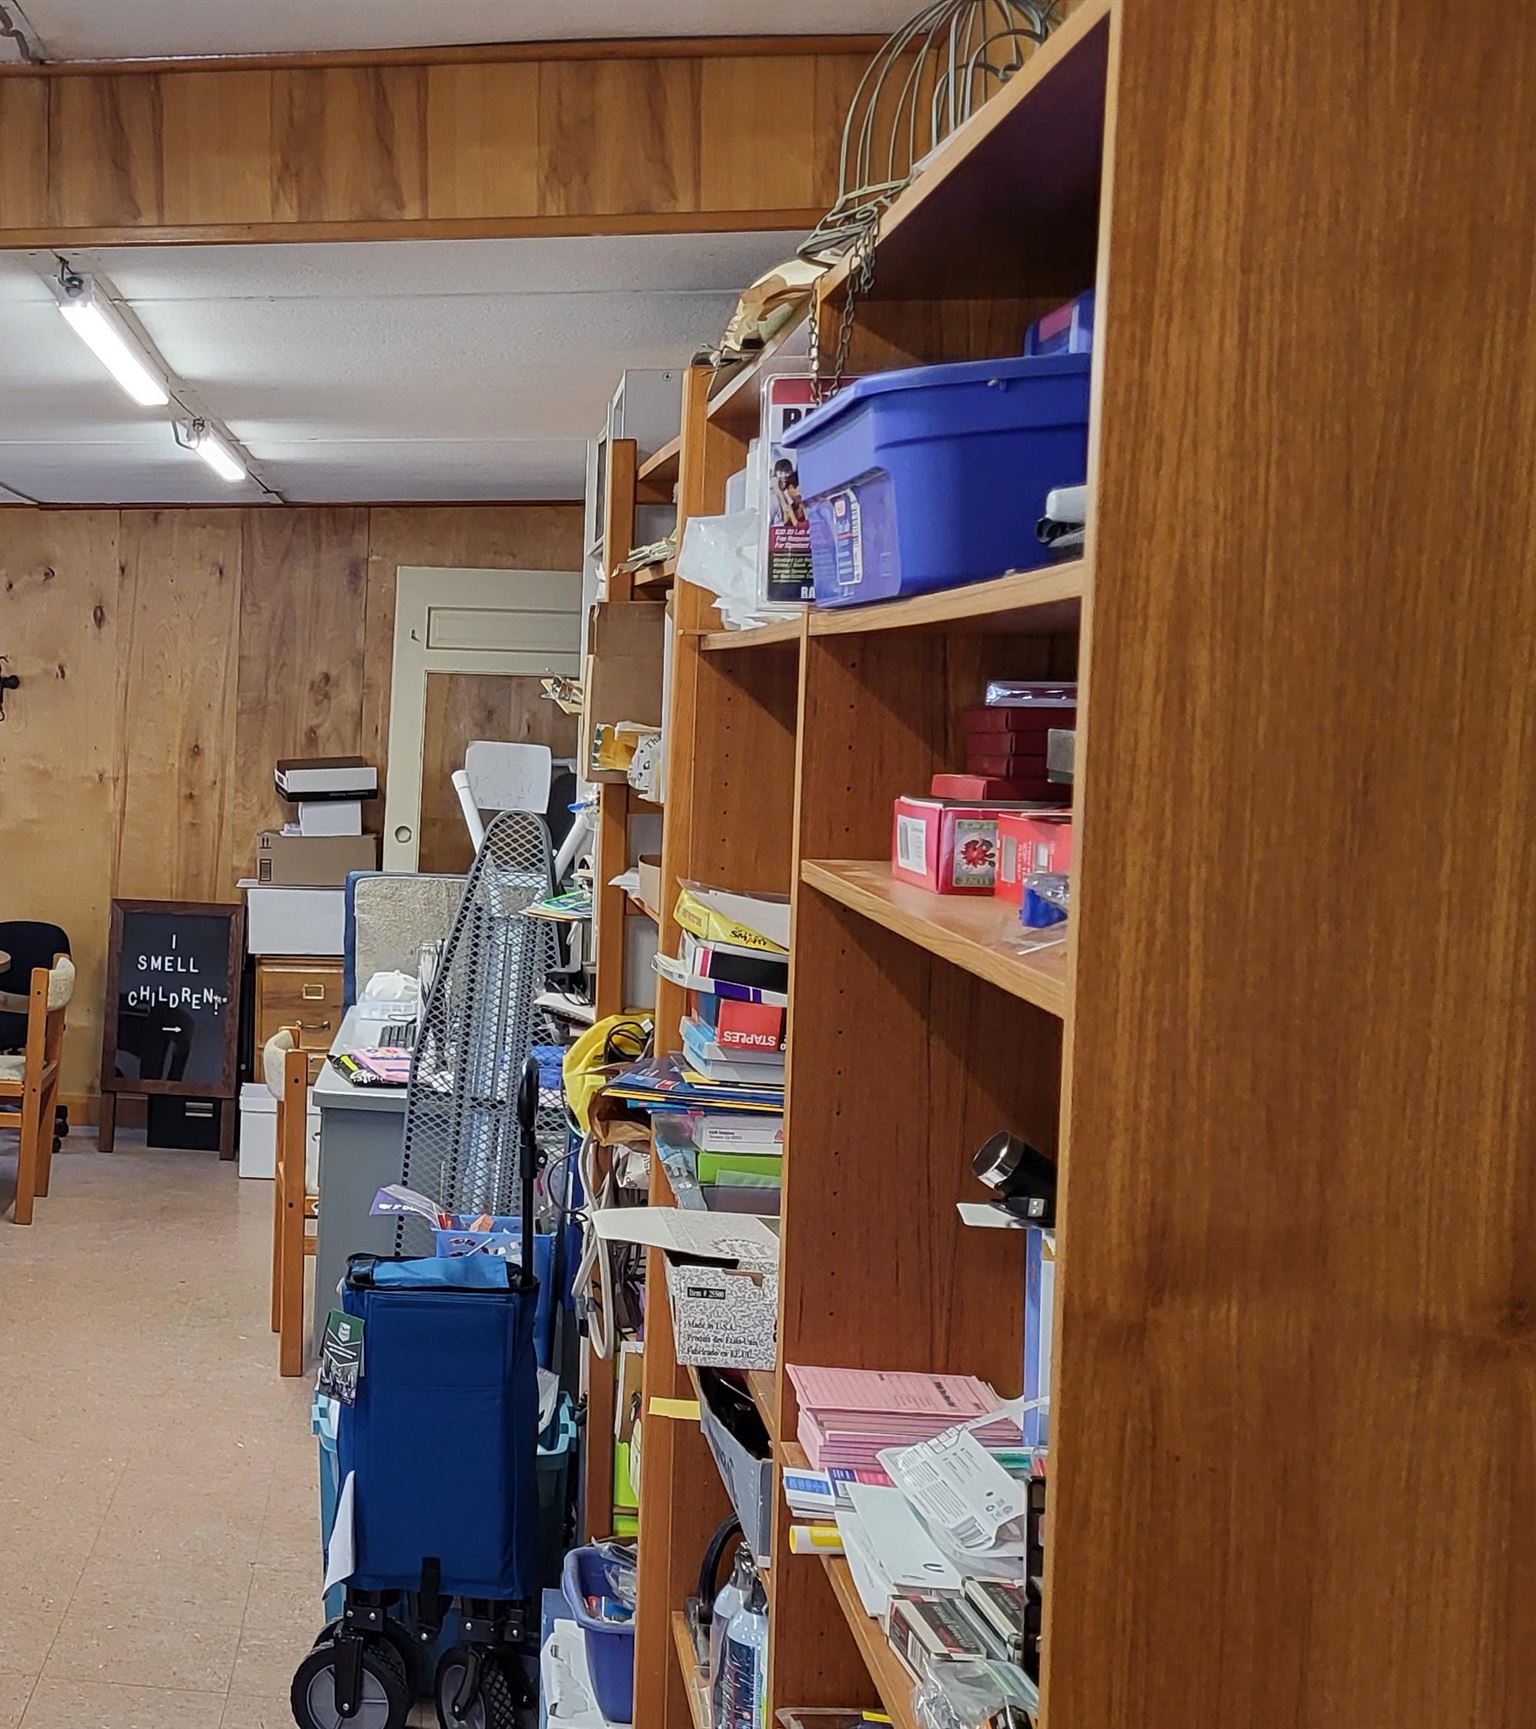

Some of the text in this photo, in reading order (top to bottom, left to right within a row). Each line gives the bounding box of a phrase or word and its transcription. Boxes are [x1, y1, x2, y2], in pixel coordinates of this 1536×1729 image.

[171, 934, 177, 950] I
[137, 955, 199, 973] SMELL
[723, 1030, 776, 1047] STAPLES
